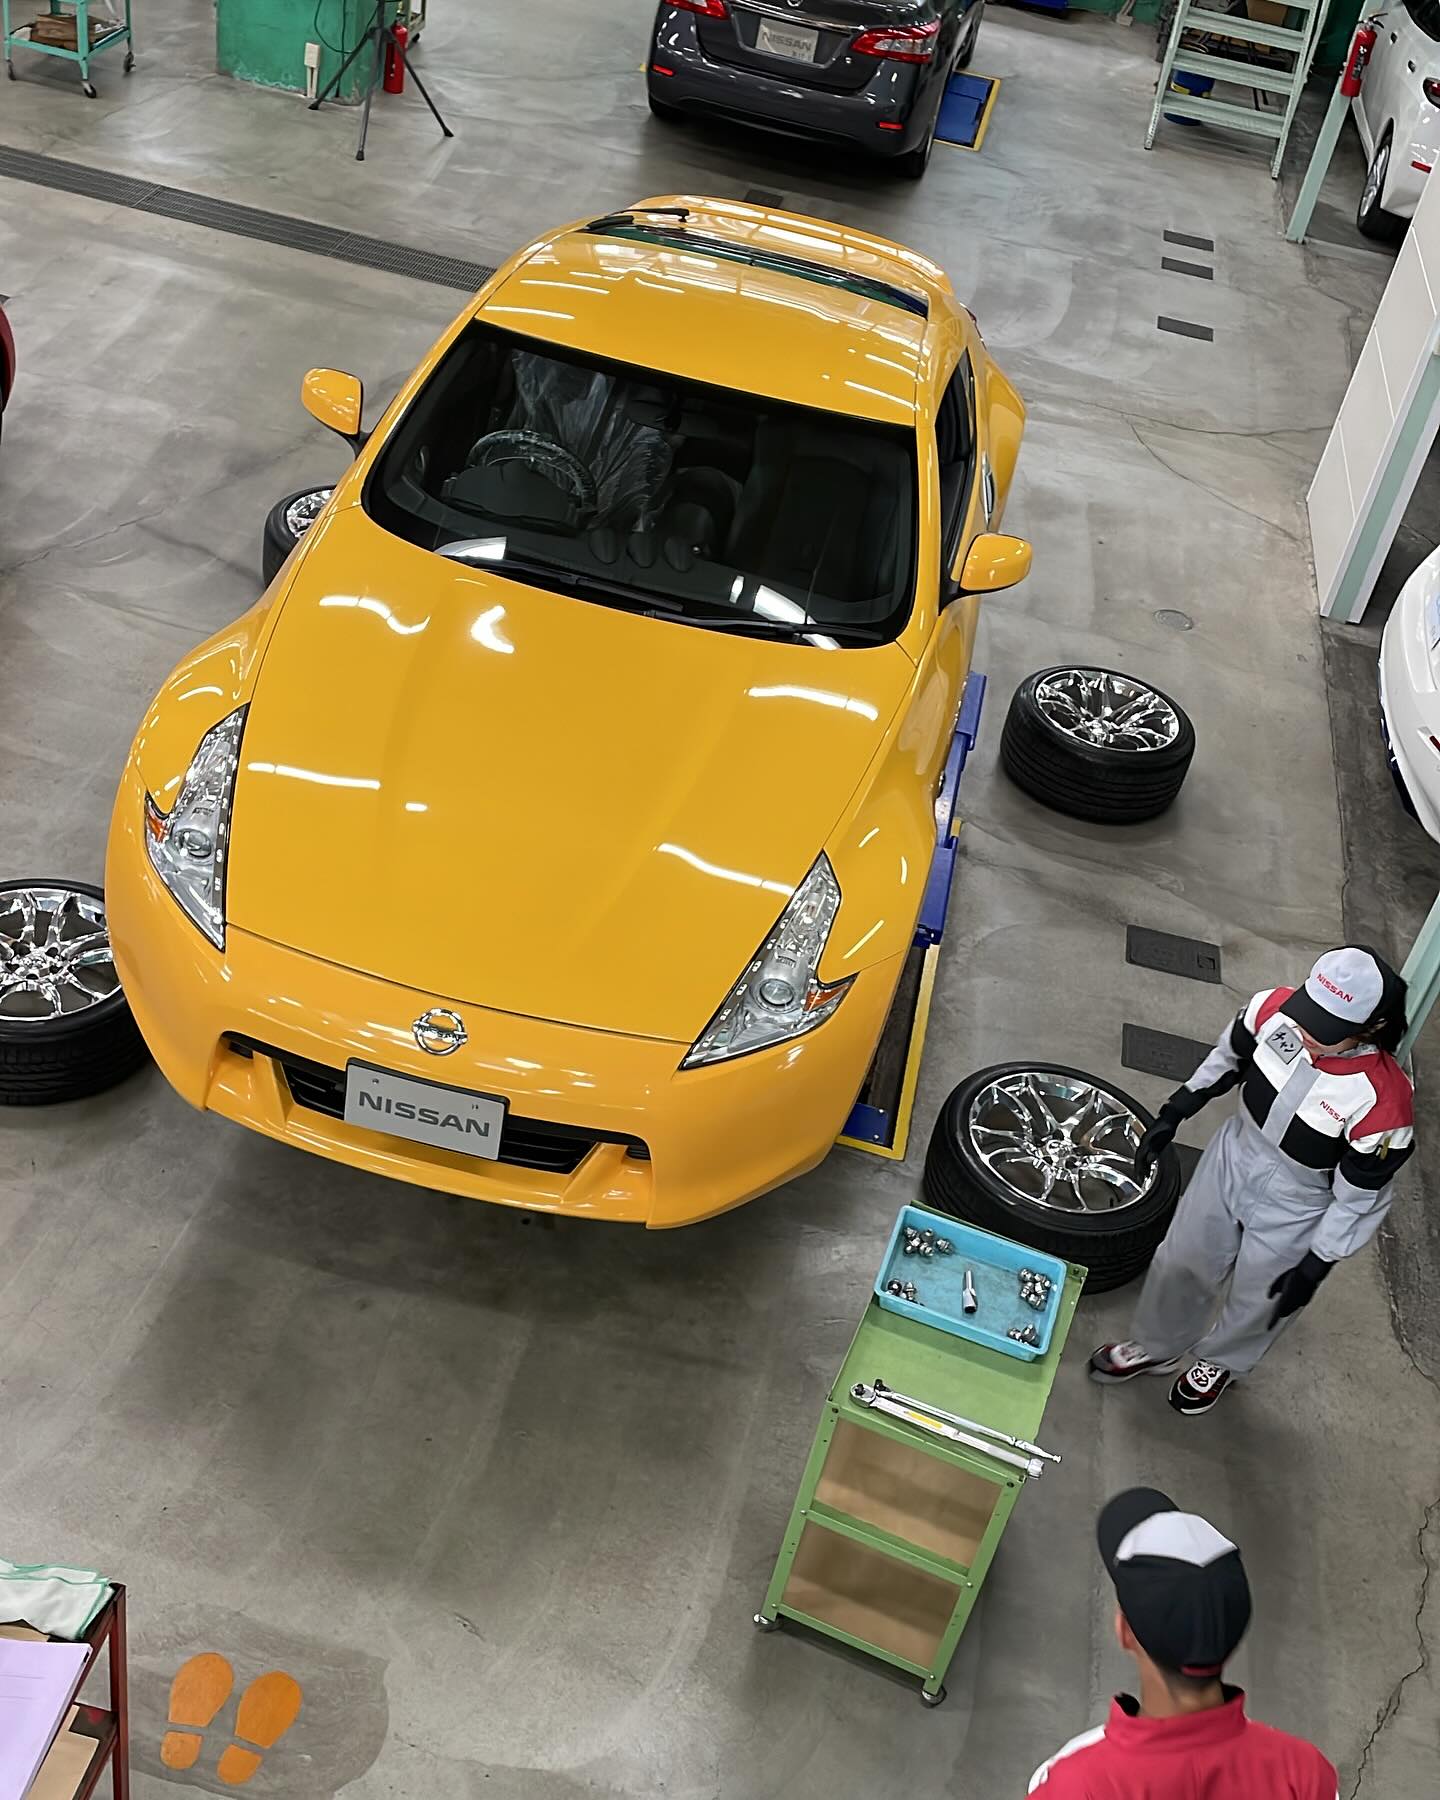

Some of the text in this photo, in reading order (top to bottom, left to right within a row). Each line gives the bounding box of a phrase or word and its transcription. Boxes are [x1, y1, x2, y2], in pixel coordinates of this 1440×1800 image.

[762, 32, 812, 51] NISSAN
[1316, 973, 1354, 1003] NISSAN
[359, 1091, 490, 1138] NISSAN
[1319, 1100, 1347, 1123] NISSA
